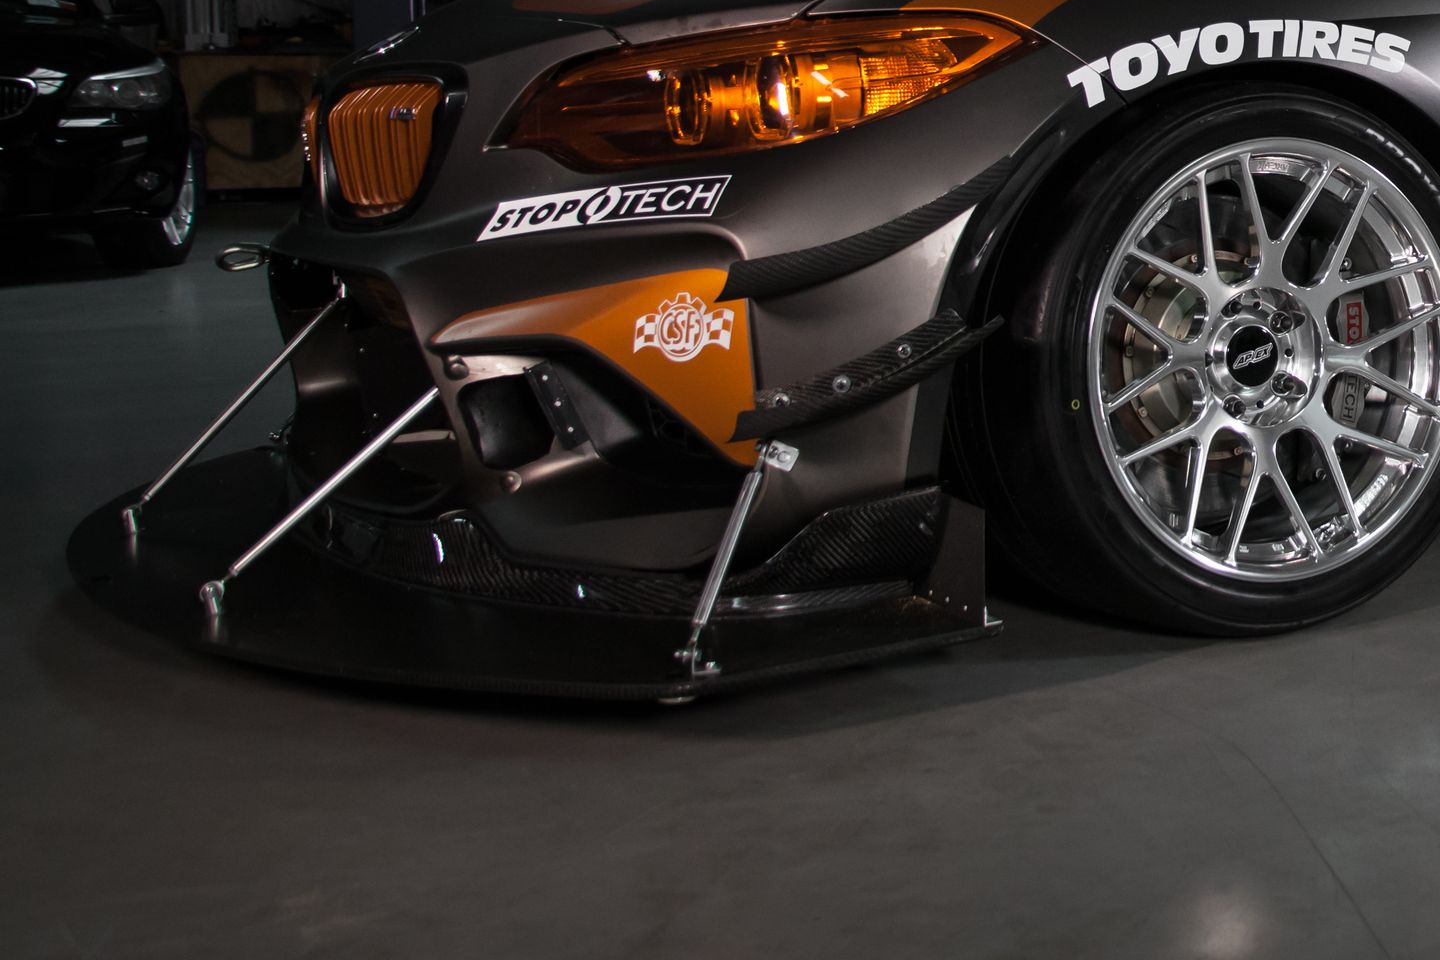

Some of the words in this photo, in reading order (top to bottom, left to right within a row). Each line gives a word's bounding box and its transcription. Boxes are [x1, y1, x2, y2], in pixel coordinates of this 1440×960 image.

[1066, 21, 1245, 109] TOYO
[1248, 19, 1412, 74] TIRES
[660, 309, 702, 346] CSF
[1348, 306, 1361, 341] STO
[1235, 345, 1272, 368] APEX
